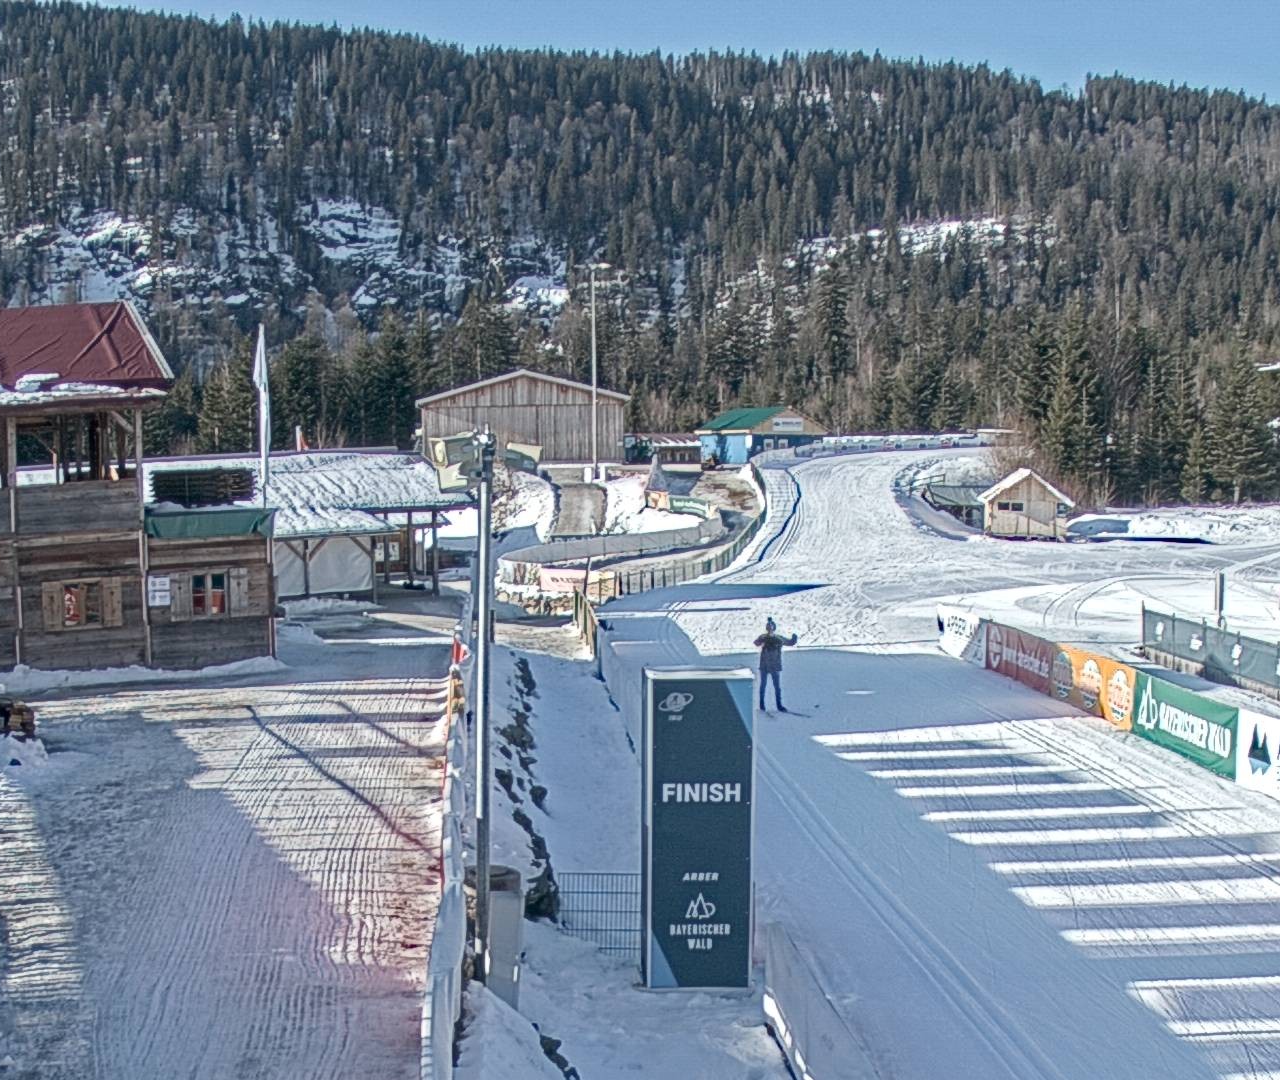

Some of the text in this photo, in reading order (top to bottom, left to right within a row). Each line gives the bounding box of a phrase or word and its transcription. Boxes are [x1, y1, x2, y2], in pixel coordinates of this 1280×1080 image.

[662, 783, 741, 803] FINISH
[682, 872, 719, 882] ARBER
[669, 923, 731, 936] BAYERISCHER
[687, 937, 713, 950] WALD
